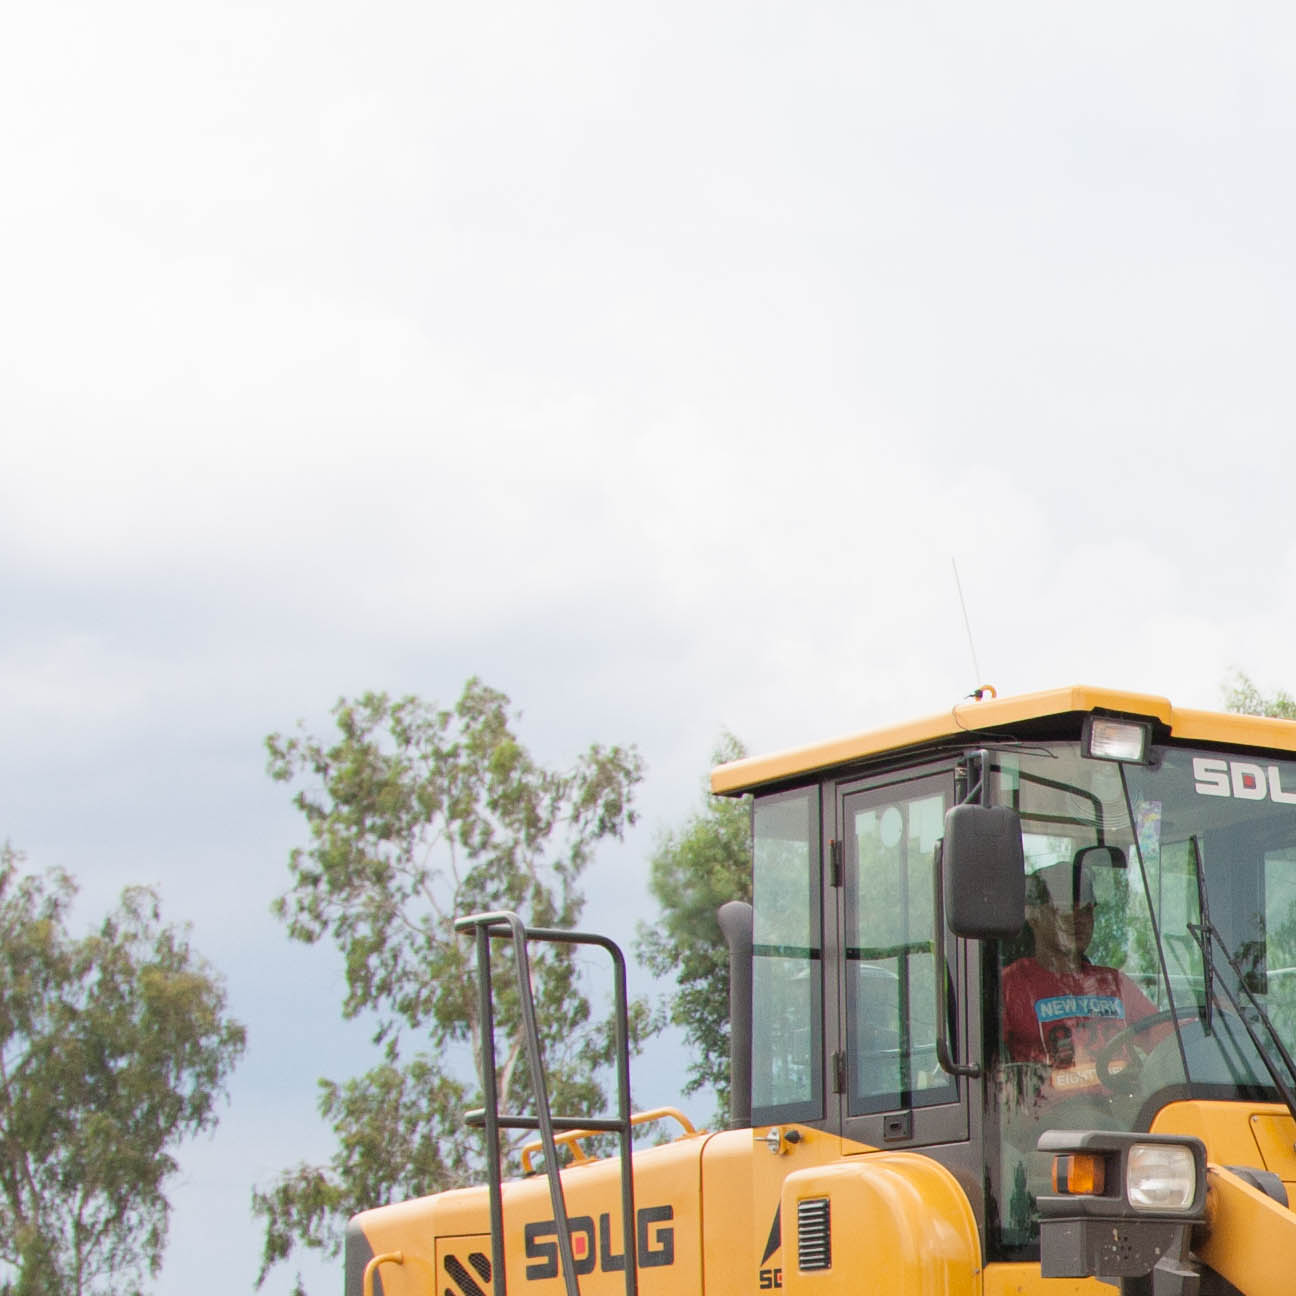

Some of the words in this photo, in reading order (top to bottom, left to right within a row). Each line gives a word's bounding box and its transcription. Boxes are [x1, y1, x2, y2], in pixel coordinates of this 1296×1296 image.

[1041, 1000, 1076, 1018] NEW
[1078, 998, 1120, 1017] YORK
[524, 1204, 674, 1281] SDLG
